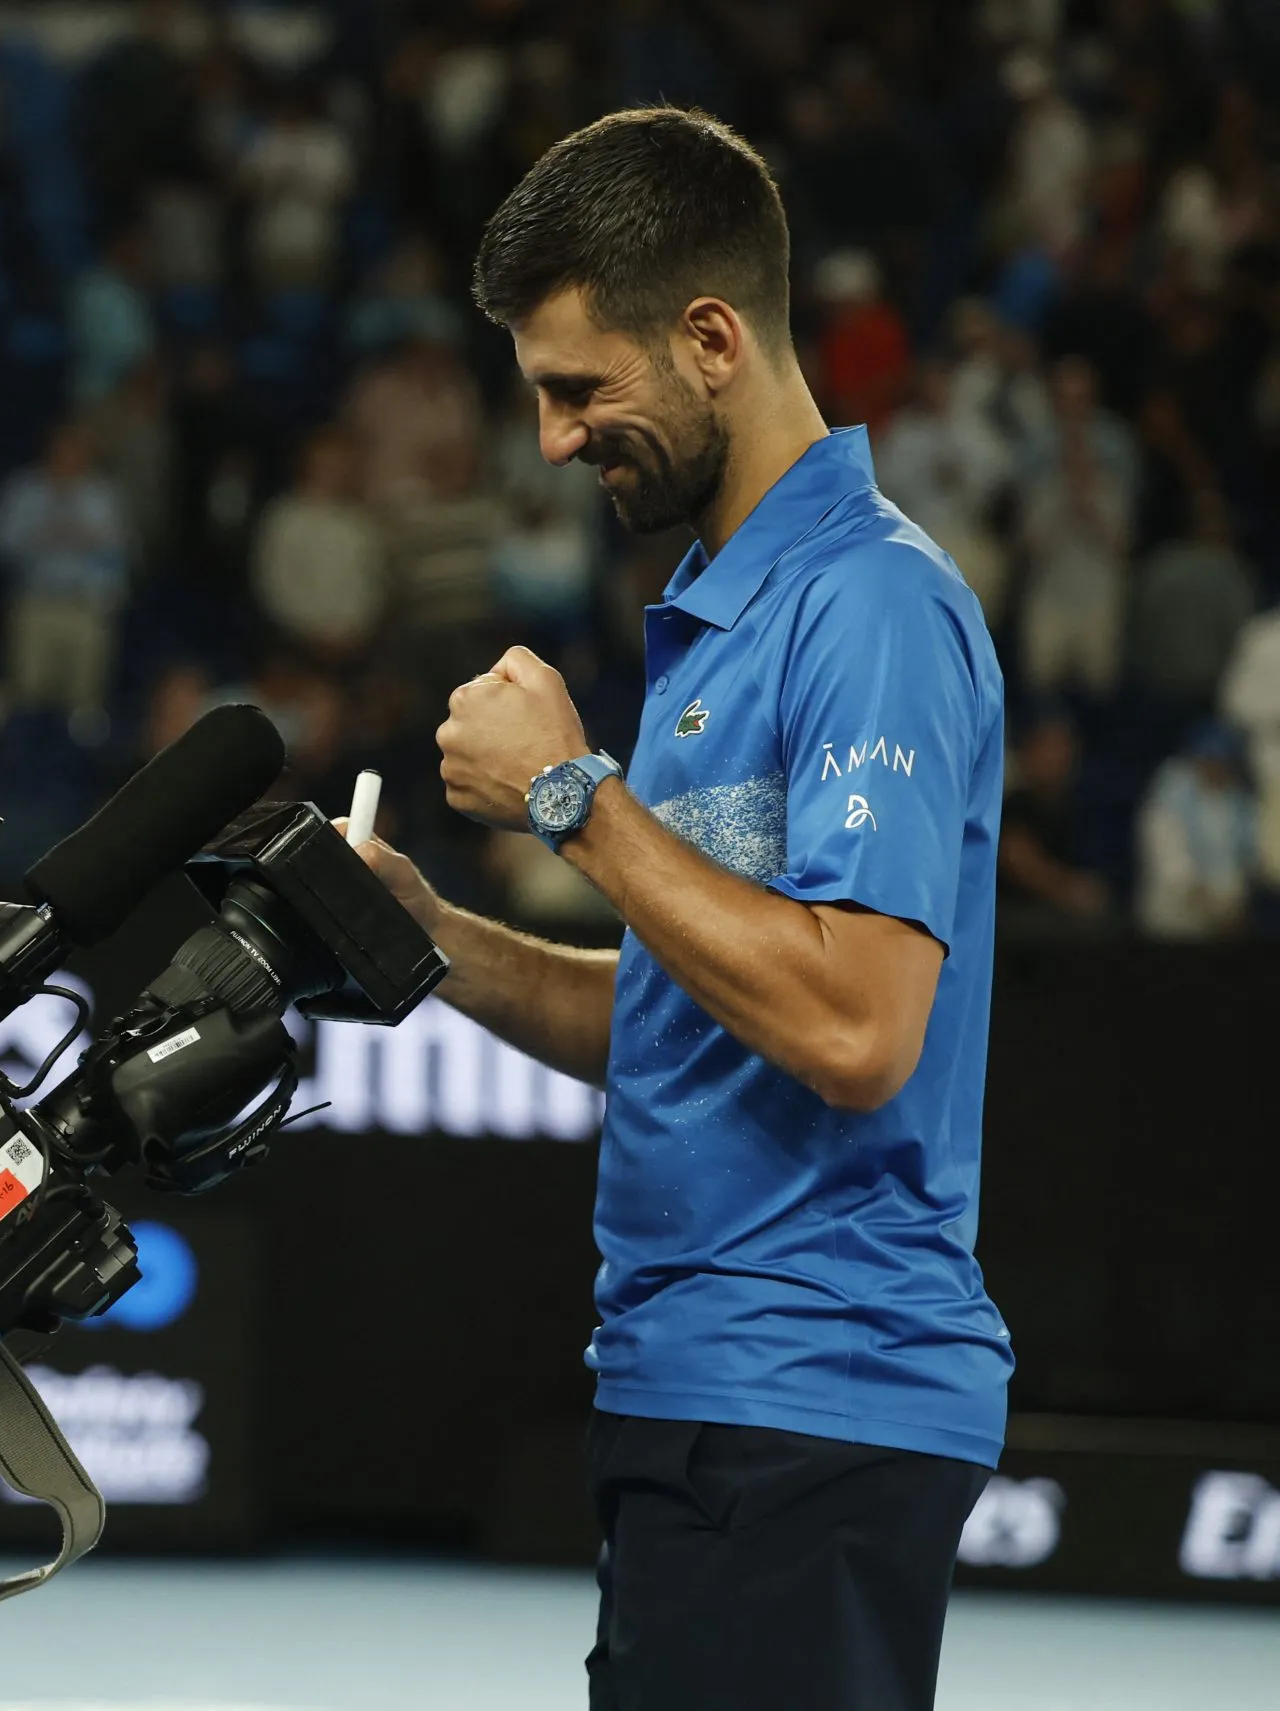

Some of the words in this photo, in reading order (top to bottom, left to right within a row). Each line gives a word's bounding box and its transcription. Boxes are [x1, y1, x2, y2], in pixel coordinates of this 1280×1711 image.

[229, 930, 251, 950] FUJINON
[250, 948, 259, 957] TV
[257, 956, 272, 973] ZOOM
[228, 1104, 282, 1159] FUJINON
